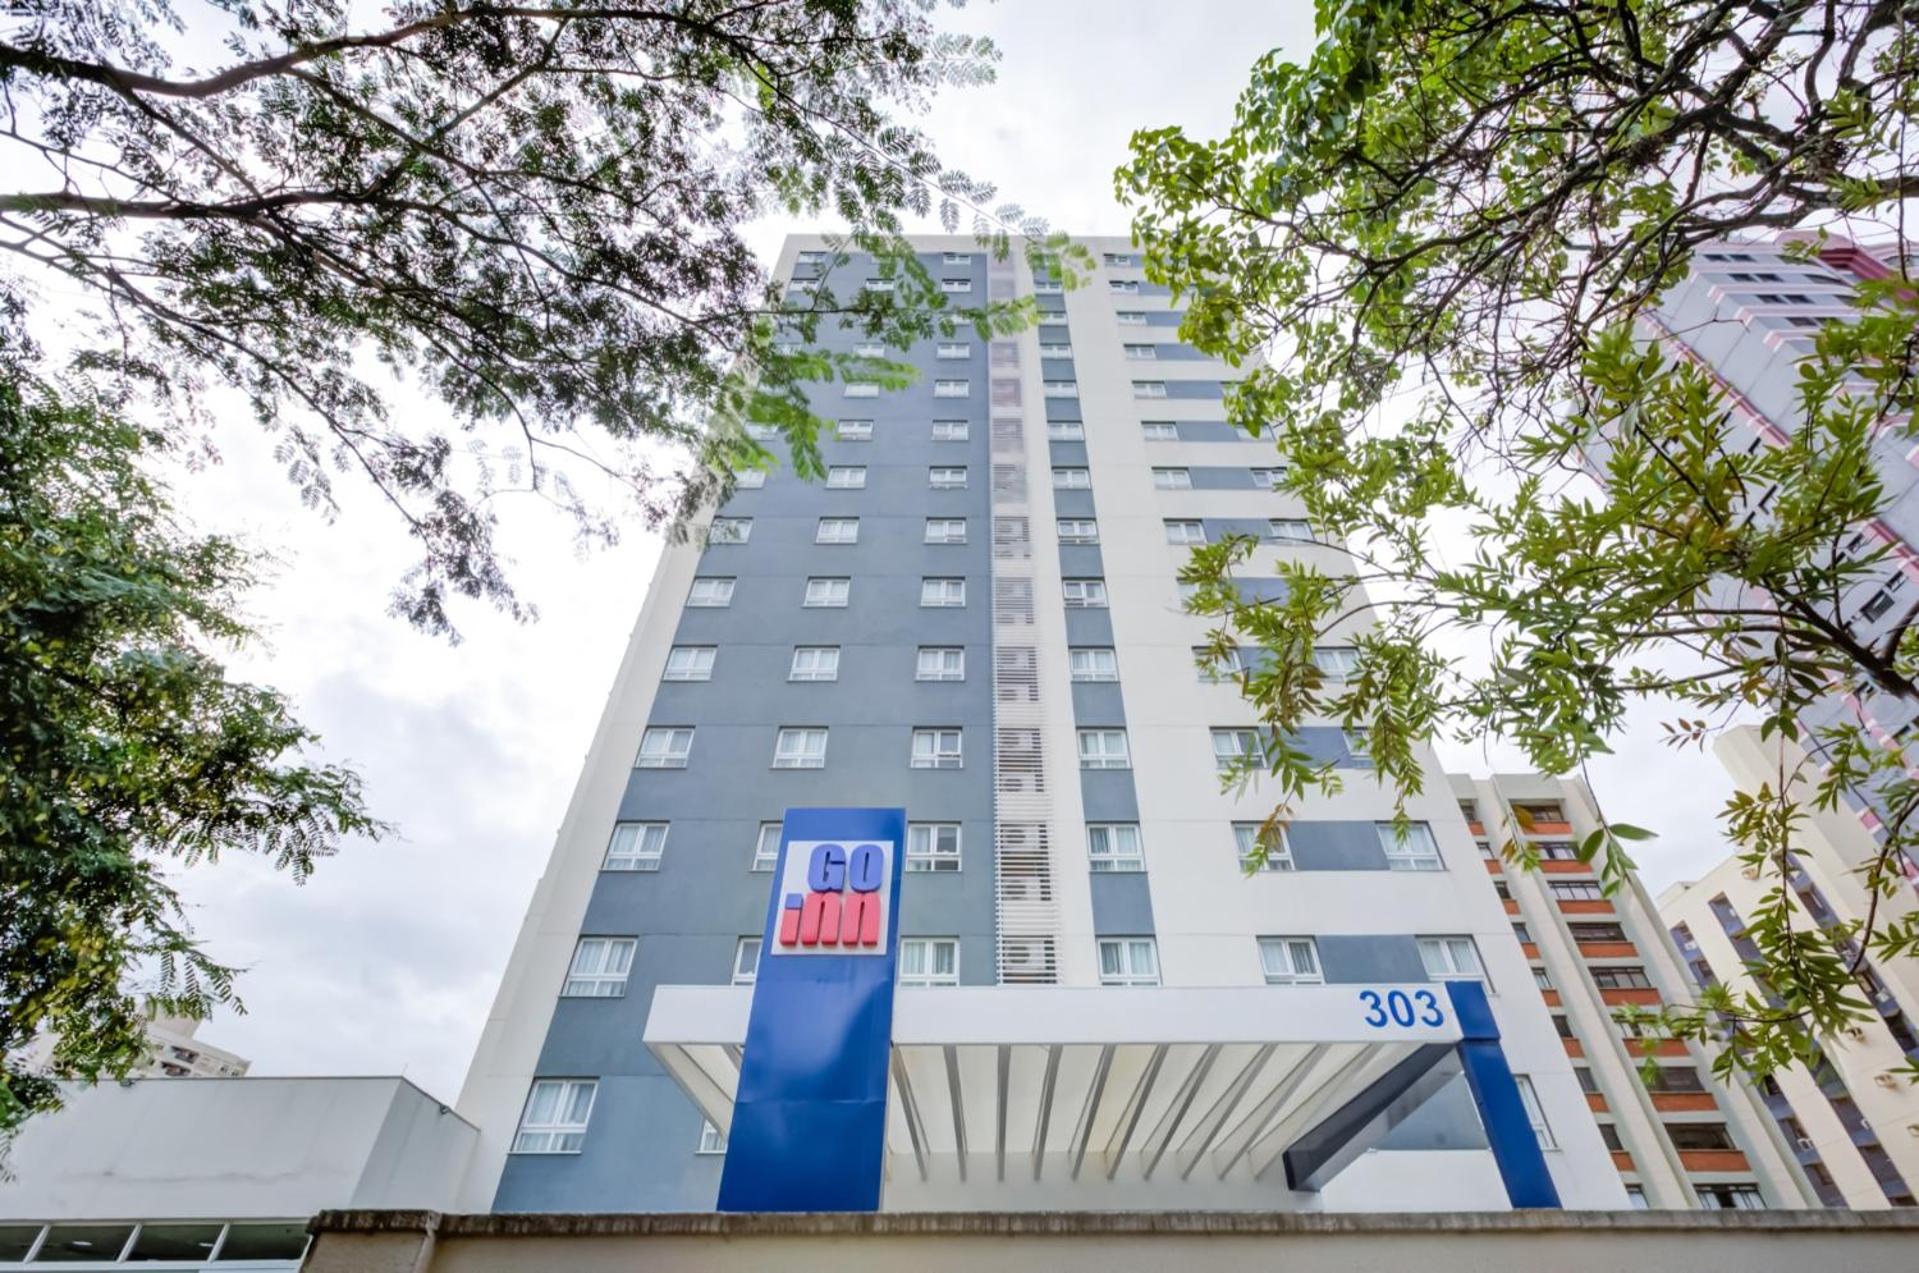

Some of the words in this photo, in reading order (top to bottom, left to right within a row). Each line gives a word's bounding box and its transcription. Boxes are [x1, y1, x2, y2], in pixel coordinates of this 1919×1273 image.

[808, 843, 884, 893] GO
[779, 892, 881, 947] inn
[1359, 989, 1444, 1028] 303
